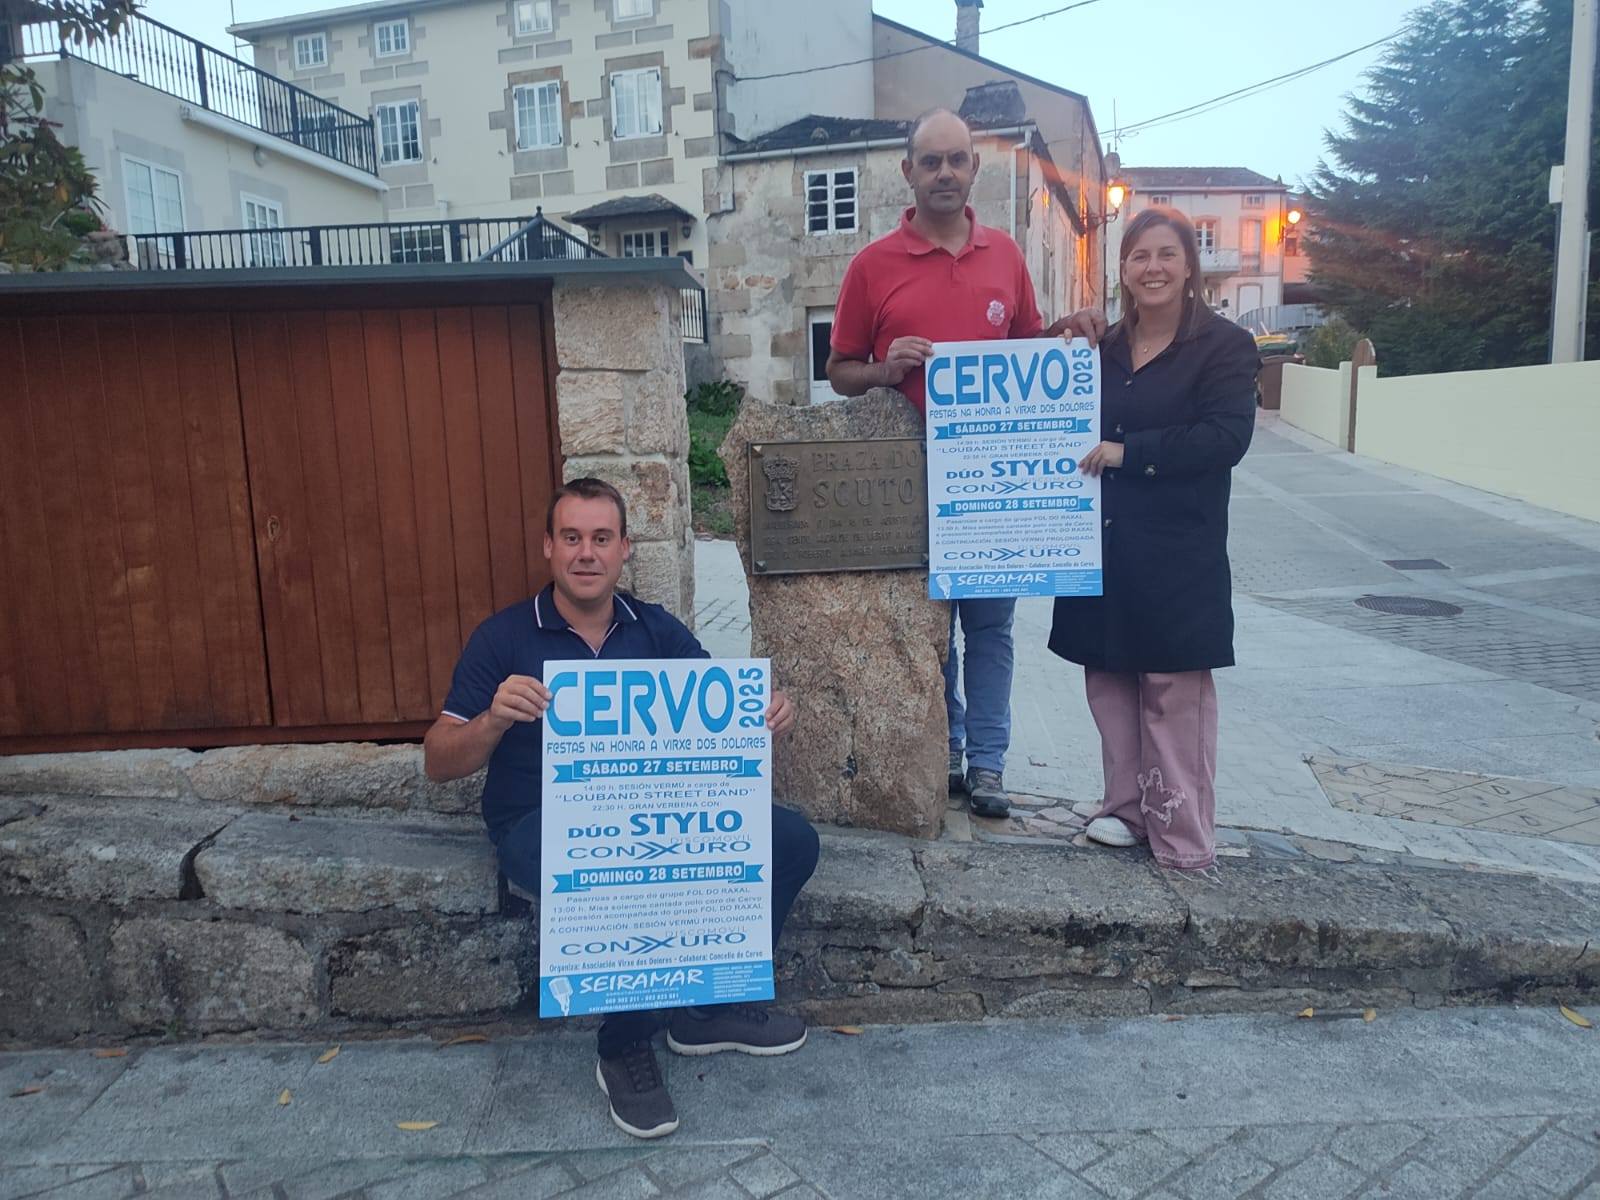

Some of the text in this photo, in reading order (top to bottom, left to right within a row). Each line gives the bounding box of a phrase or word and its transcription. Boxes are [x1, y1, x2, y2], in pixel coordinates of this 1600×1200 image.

[927, 348, 1070, 406] CERVO
[1072, 348, 1094, 396] 2025
[960, 408, 972, 417] NA
[975, 406, 1002, 417] HONRA
[1040, 403, 1056, 413] DOS
[955, 419, 1073, 434] SÁBADO 27 SETEMBRO
[1001, 442, 1046, 451] STREET
[811, 448, 919, 473] PRAZA DO
[946, 457, 1078, 480] DÚO STYLO
[812, 476, 914, 509] SCUTO
[955, 498, 1077, 512] DOMINGO 28 SETEMBRO
[957, 572, 1049, 586] SEIRAMAR
[546, 666, 735, 737] CERVO
[738, 667, 765, 729] 2025
[590, 741, 605, 753] NA
[610, 740, 646, 752] HONRA
[699, 737, 717, 750] DOS
[582, 759, 739, 776] SÁBADO 27 SETEMBRO
[644, 790, 703, 800] STREET
[628, 802, 654, 810] GRAN
[656, 801, 698, 809] VERBENA
[701, 800, 721, 808] CON
[568, 809, 743, 839] DÚO STYLO
[579, 865, 743, 885] DOMINGO 28 SETEMBRO
[701, 905, 717, 913] FOL
[633, 920, 666, 930] SESIÓN
[702, 914, 763, 924] PROLONGADA
[579, 968, 705, 995] SEIRAMAR
